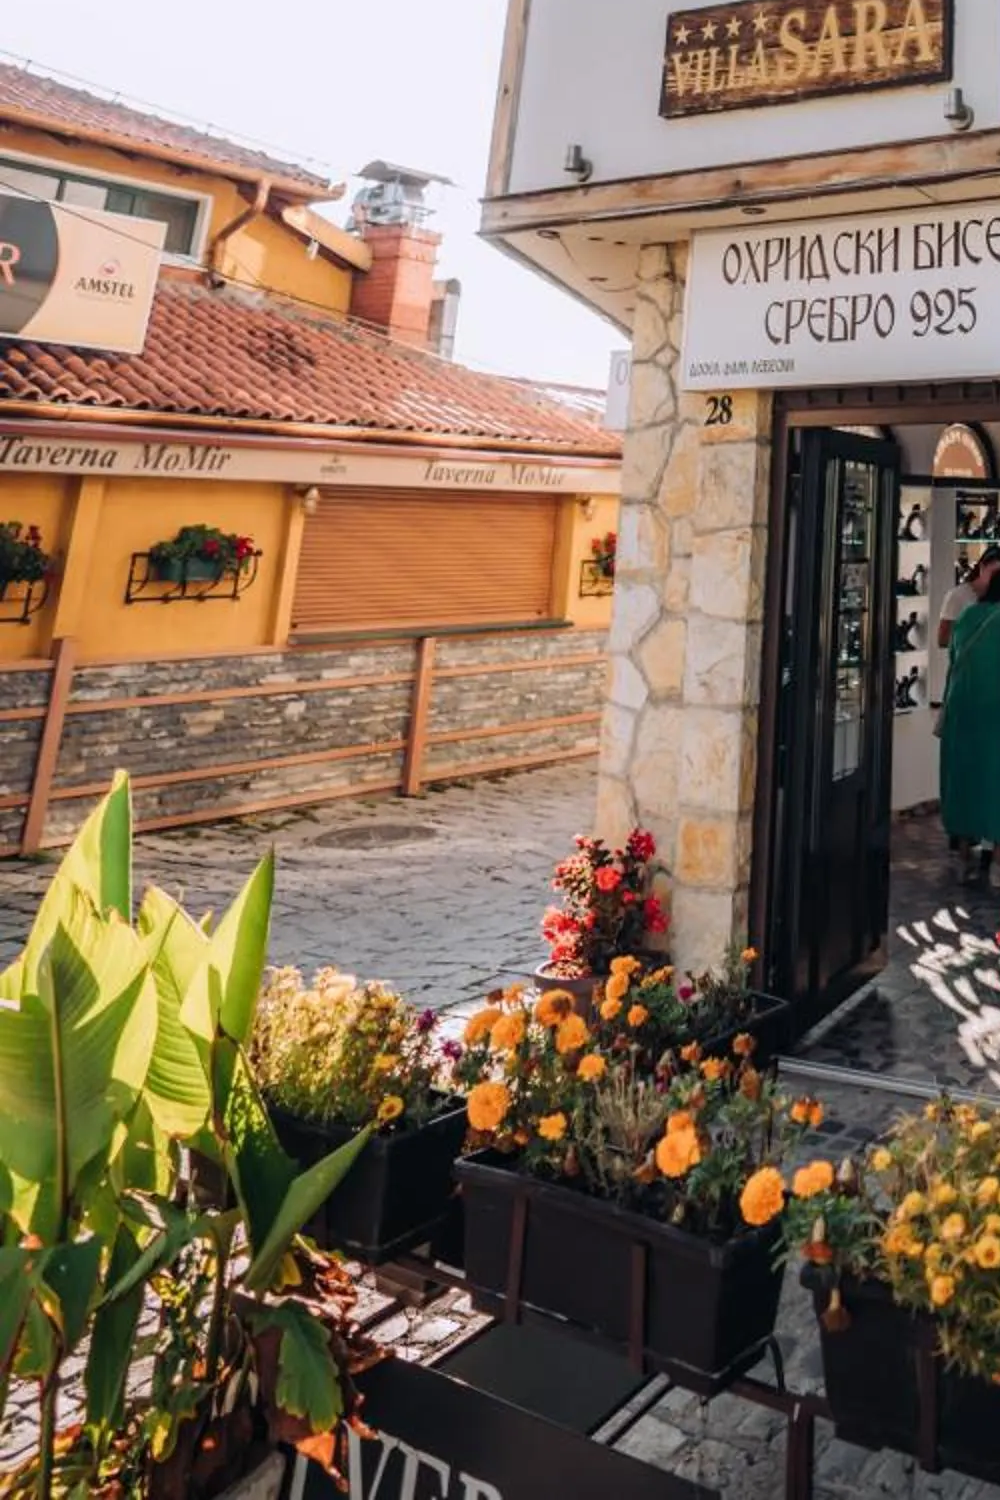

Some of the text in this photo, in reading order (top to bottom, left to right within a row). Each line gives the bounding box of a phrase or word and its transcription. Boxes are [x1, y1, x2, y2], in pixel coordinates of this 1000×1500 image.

[671, 39, 767, 97] VILLA
[722, 226, 899, 285] ОХРИДСКИ
[74, 276, 135, 298] AMSTEL
[764, 286, 977, 345] СРЕБРО 925
[704, 394, 733, 426] 28
[0, 435, 231, 472] Taverna MoMir
[422, 457, 495, 485] Taverna
